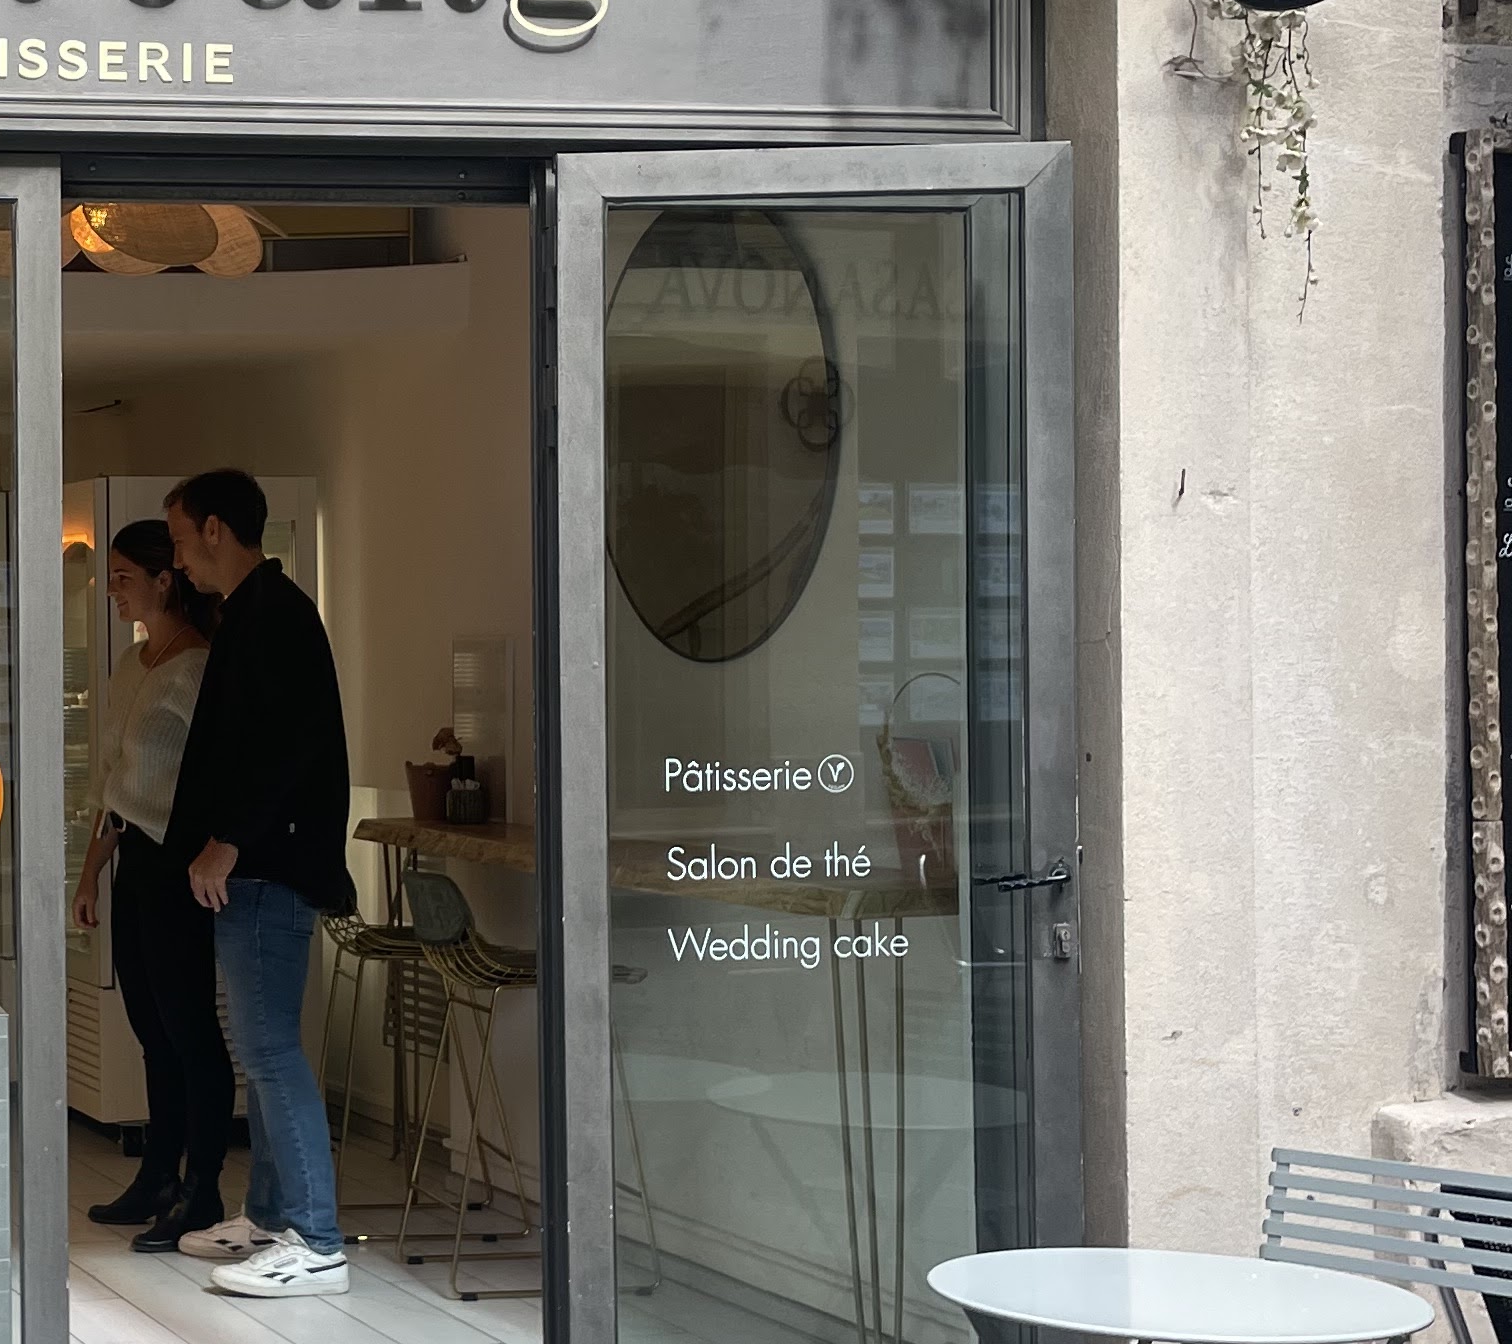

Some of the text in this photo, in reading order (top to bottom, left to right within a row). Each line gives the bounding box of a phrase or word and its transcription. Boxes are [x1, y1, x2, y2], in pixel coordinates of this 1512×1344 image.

[664, 757, 812, 792] Pâtisserie
[666, 840, 871, 881] Salon de thé
[667, 921, 909, 969] Wedding cake
